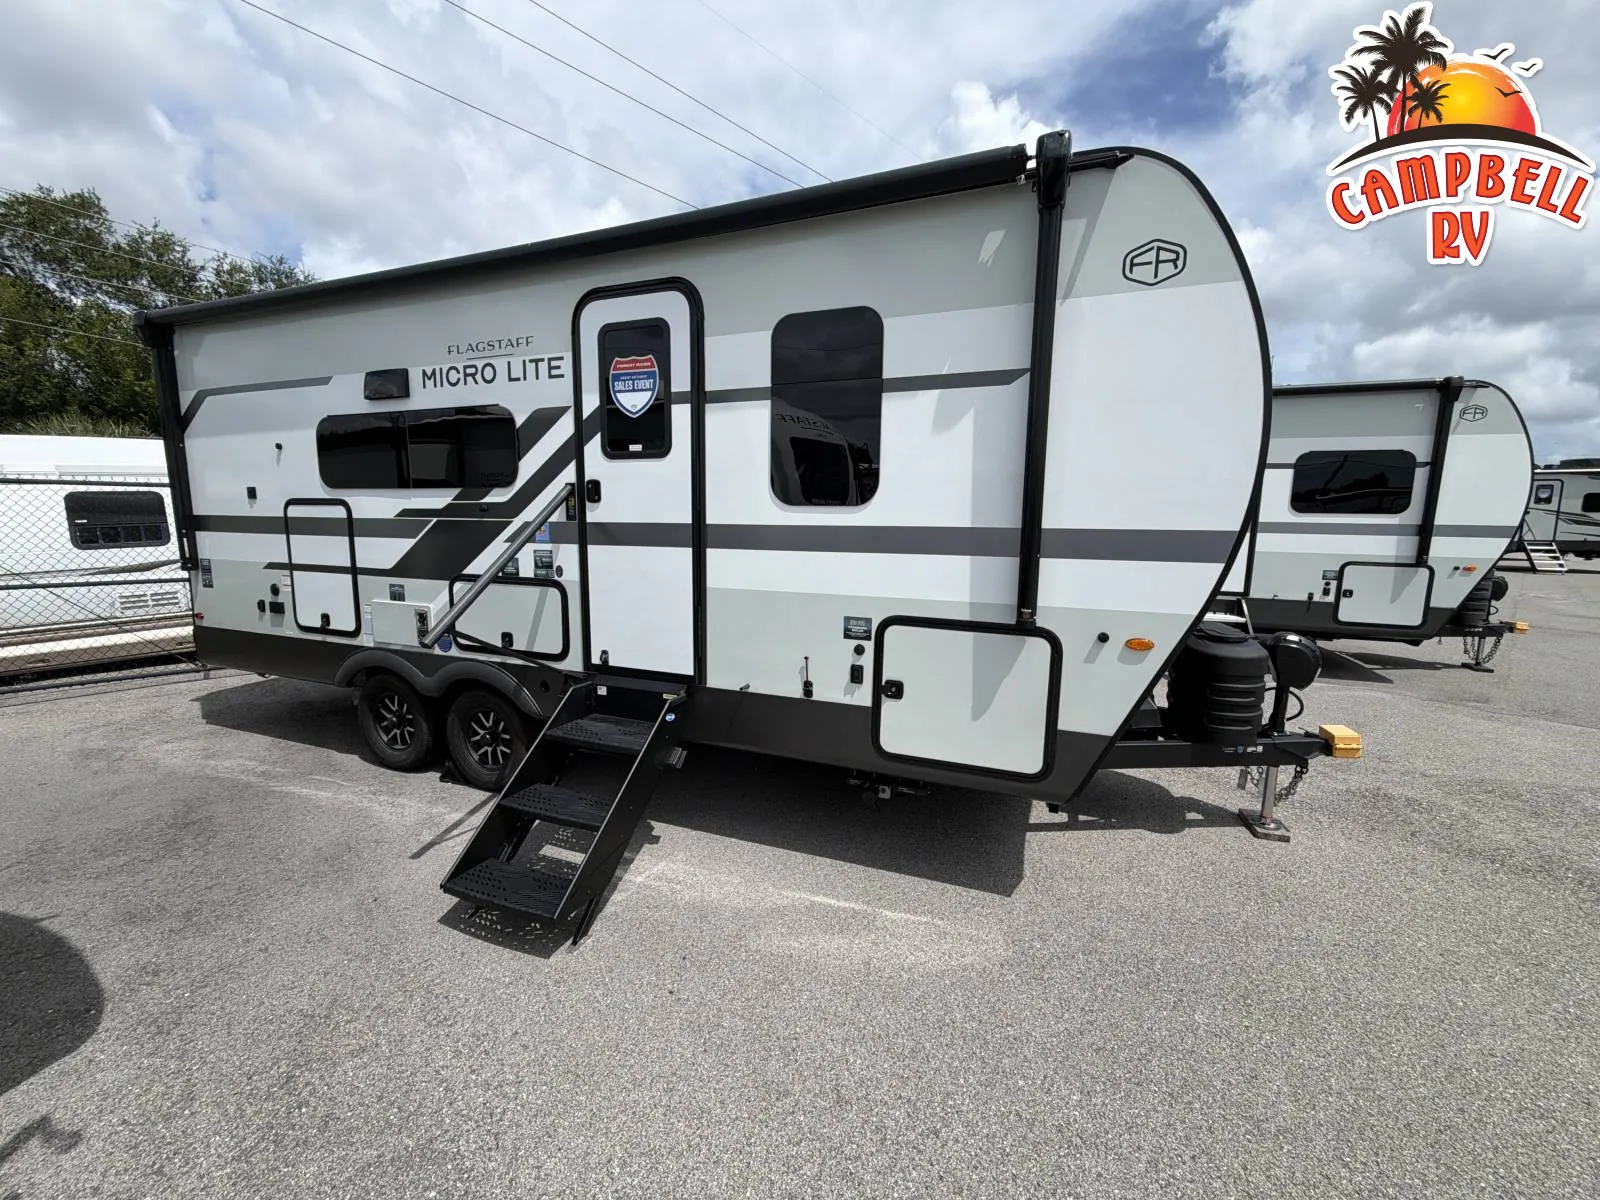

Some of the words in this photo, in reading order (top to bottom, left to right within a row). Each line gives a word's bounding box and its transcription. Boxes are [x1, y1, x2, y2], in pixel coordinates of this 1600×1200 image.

[447, 335, 535, 356] FLAGSTAFF
[422, 361, 498, 390] MICRO
[507, 356, 565, 383] LITE
[614, 380, 633, 391] SALES
[634, 379, 654, 390] EVENT
